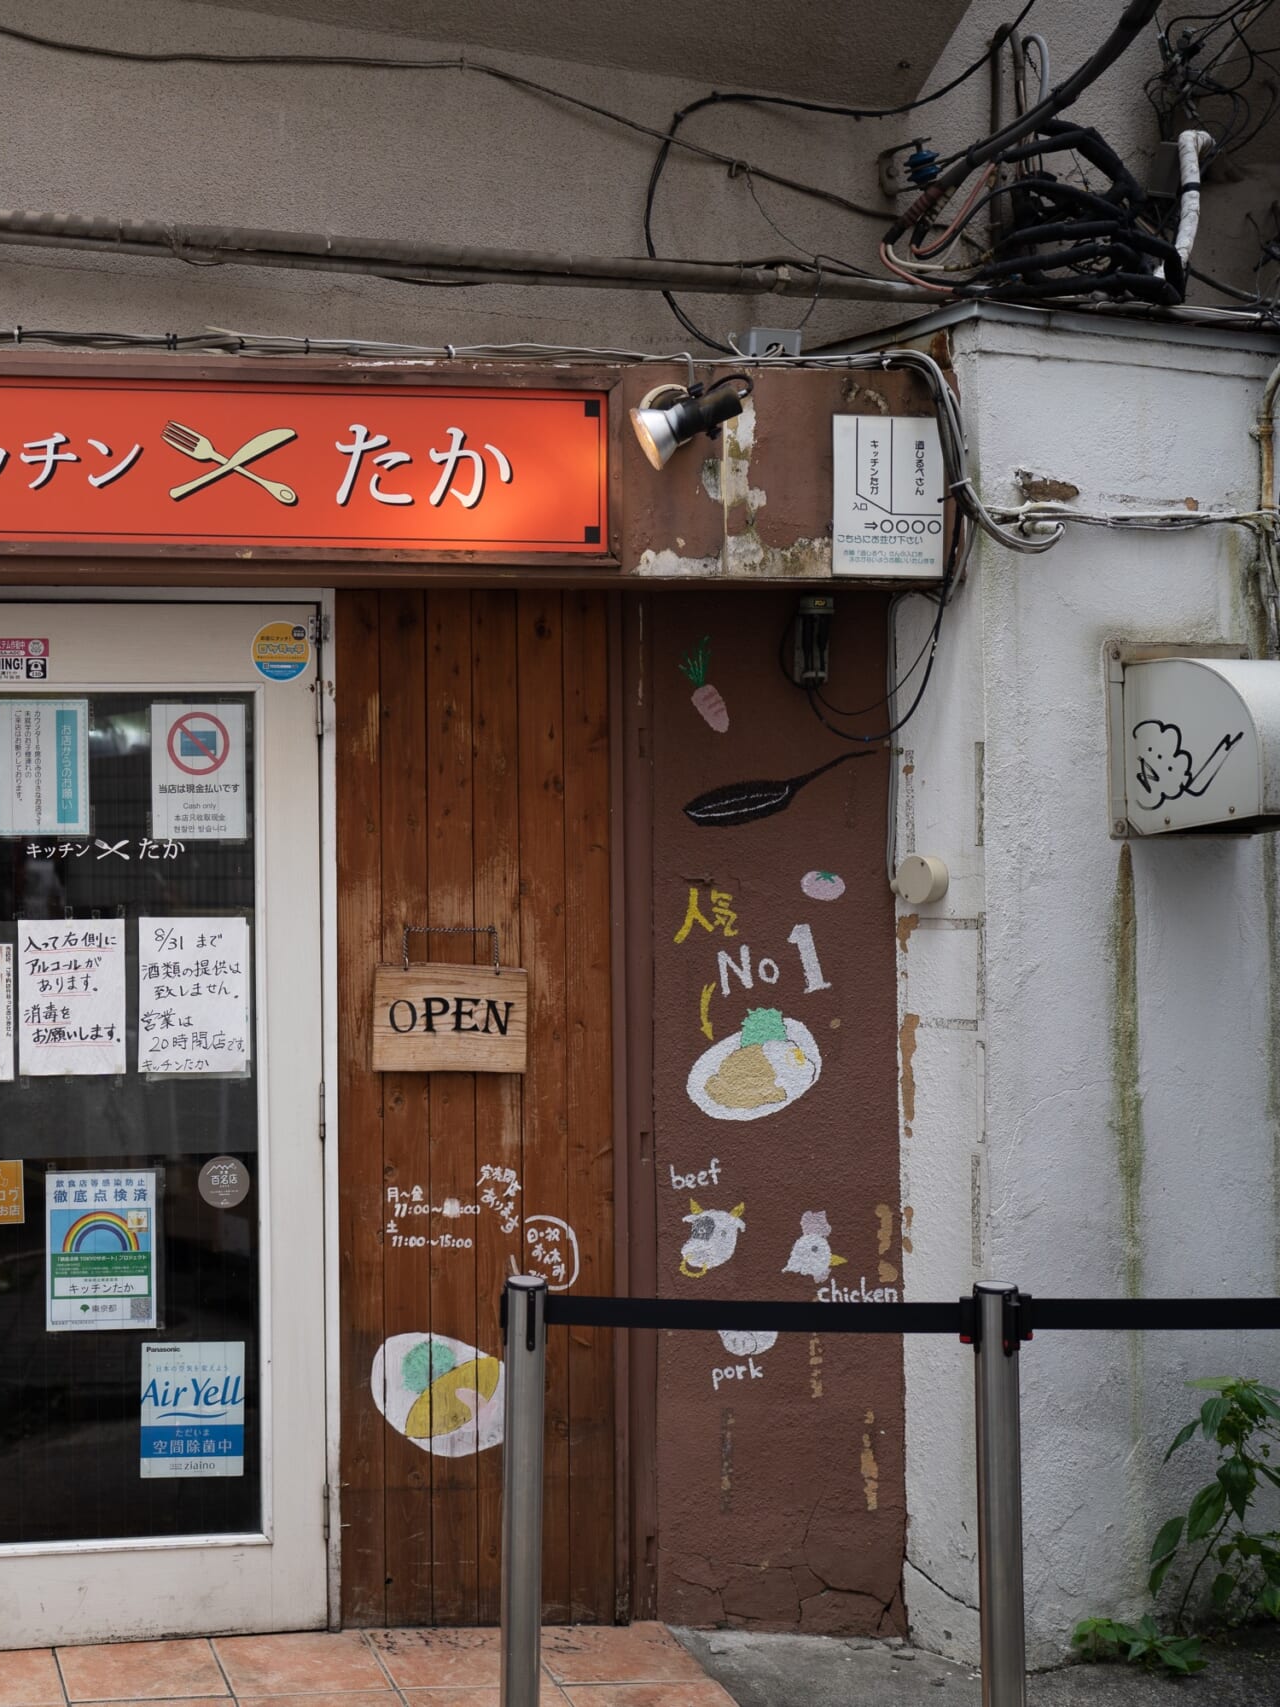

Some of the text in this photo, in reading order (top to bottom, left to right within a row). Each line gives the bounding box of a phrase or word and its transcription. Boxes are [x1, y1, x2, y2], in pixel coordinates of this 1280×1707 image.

[335, 423, 514, 510] たか
[852, 502, 868, 511] 入口
[836, 534, 924, 545] こちらにお並び下さい
[61, 725, 73, 810] お店からのお願い
[158, 784, 240, 794] 当店は現金払いです
[183, 802, 217, 811] Cash only
[26, 838, 185, 859] キッチン たか
[673, 888, 739, 944] 人気
[24, 932, 118, 952] 入って右側に
[154, 927, 223, 952] 8/31 まで
[25, 956, 102, 976] アルコールが
[141, 959, 242, 980] 酒類の提供は
[717, 944, 780, 997] No
[37, 973, 98, 993] あります。
[24, 1002, 71, 1023] 消毒を
[141, 1008, 194, 1032] 営業は
[388, 996, 514, 1036] OPEN
[32, 1023, 121, 1044] お願いします。
[141, 1059, 210, 1072] キッチンたか
[669, 1158, 721, 1191] beef
[53, 1188, 148, 1204] 徹底点検済
[386, 1220, 398, 1234] 土
[69, 1282, 134, 1295] キッチンたか
[817, 1276, 899, 1303] chicken
[711, 1358, 764, 1390] pork
[141, 1375, 245, 1407] Air Yell
[175, 1428, 211, 1438] ただいま
[153, 1439, 232, 1455] 空間除菌中
[184, 1461, 215, 1471] ziaino
